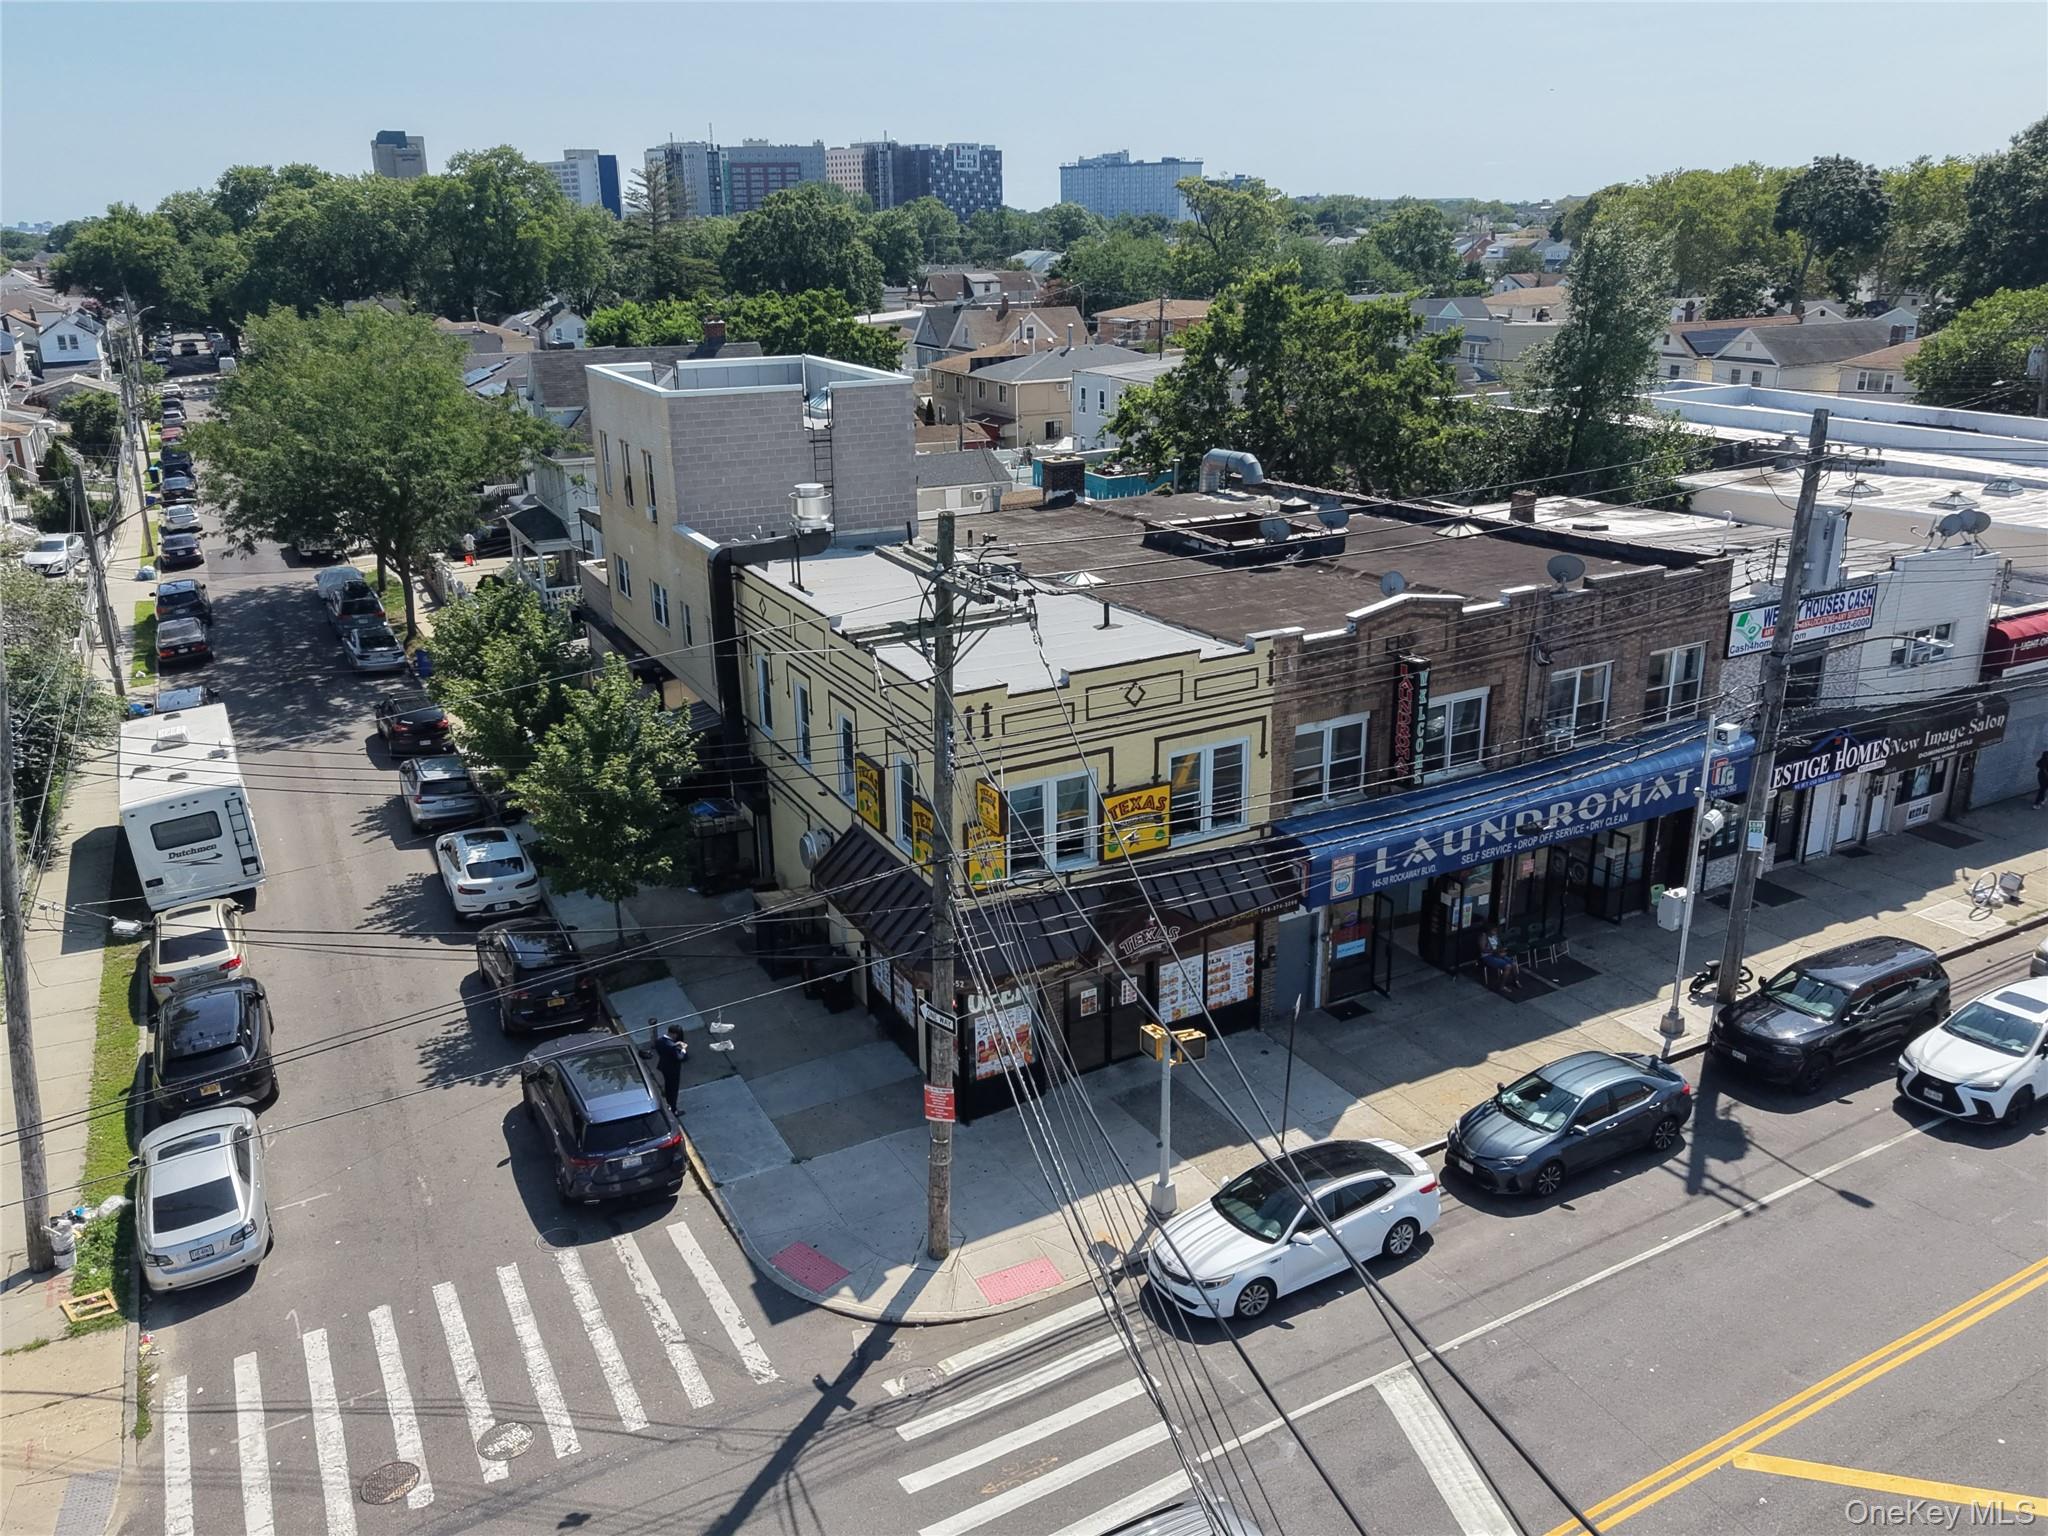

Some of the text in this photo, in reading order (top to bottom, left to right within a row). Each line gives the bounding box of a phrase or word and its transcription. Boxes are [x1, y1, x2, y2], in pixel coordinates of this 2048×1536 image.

[1764, 606, 1780, 627] WE
[1806, 594, 1846, 618] HOUSES
[1847, 588, 1875, 609] CASH
[1823, 617, 1870, 635] 718-322-6000
[1890, 738, 1920, 756] New
[1924, 725, 1966, 747] Image
[1968, 714, 2006, 735] Salon
[1772, 737, 1891, 789] ESTIGE HOMES
[913, 811, 933, 832] TEX
[1107, 794, 1168, 821] TEXAS
[1376, 768, 1696, 875] LAUNDROMAT
[168, 844, 217, 860] Dutchmen
[1461, 812, 1629, 865] SELF SERVICE DROP OFF SERVICE DRY CLEAN
[1389, 869, 1421, 884] ROCKAWAY
[1119, 926, 1181, 955] TEXAS
[927, 1009, 952, 1028] ONE WAY
